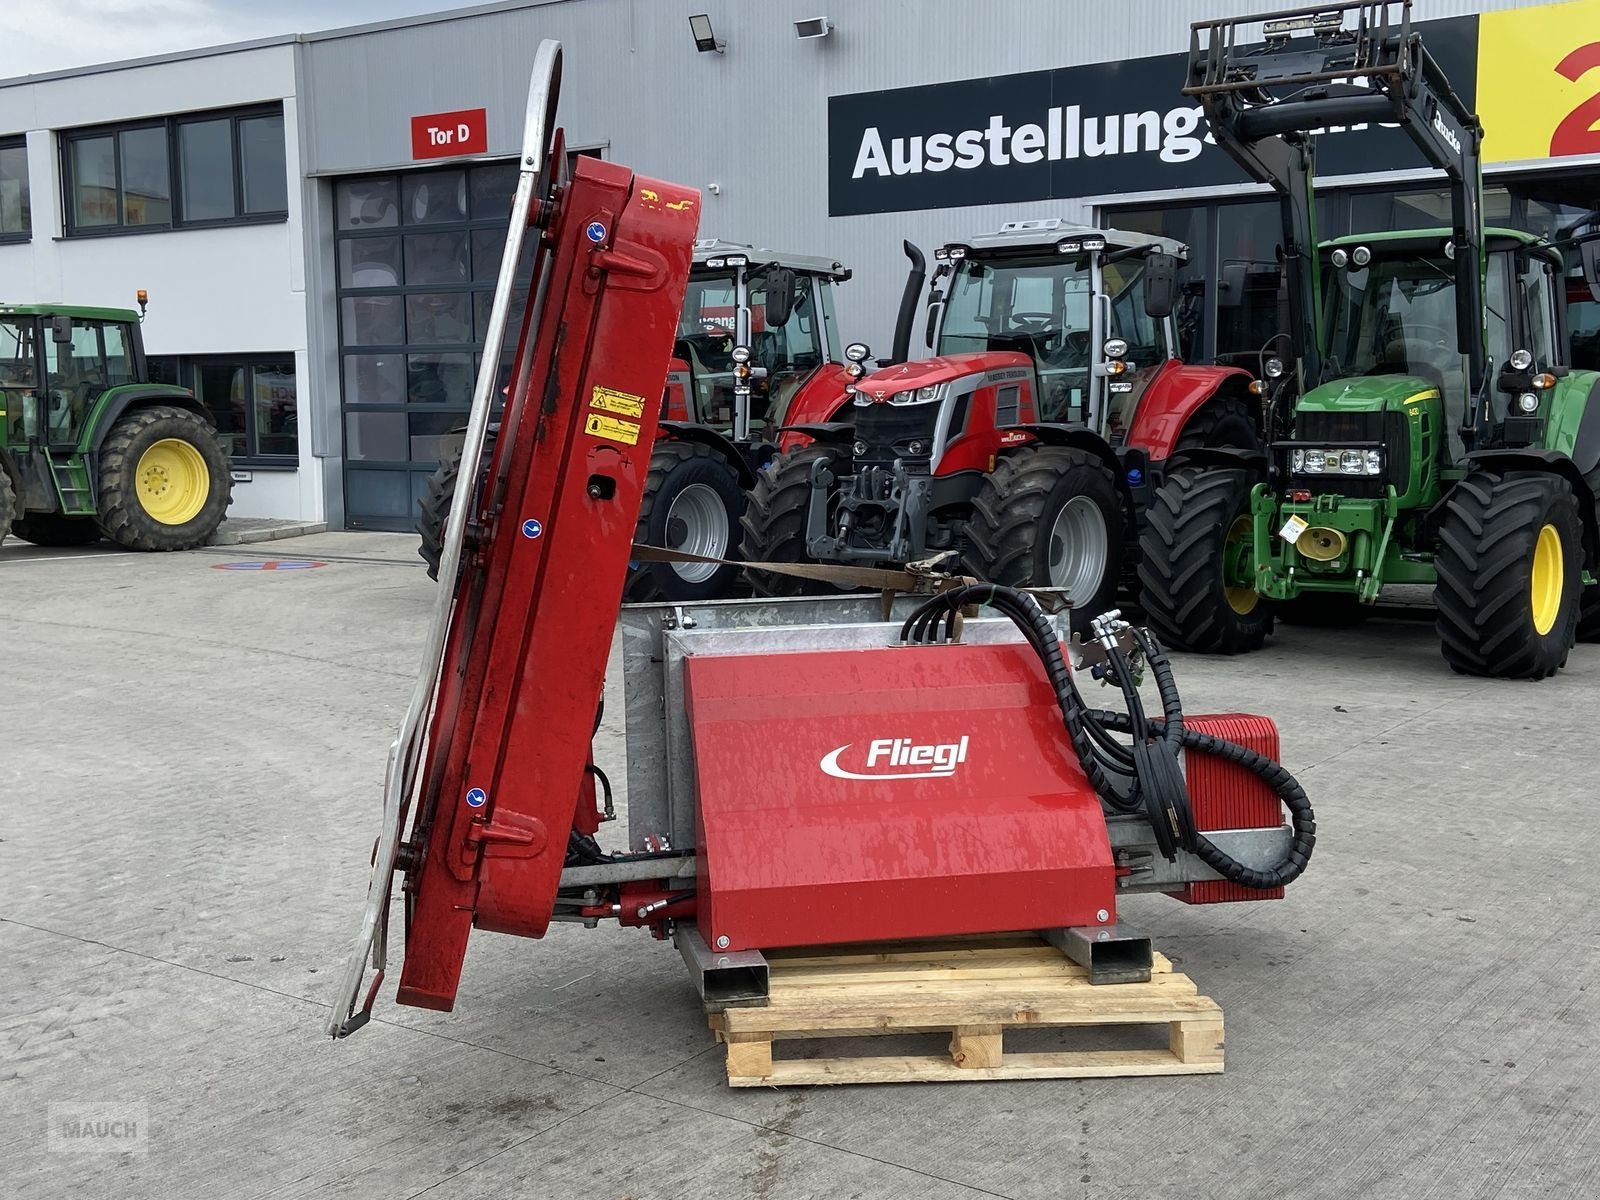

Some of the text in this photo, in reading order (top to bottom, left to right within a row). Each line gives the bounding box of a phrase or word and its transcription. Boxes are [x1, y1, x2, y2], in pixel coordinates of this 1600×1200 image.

[427, 124, 470, 146] Tor D
[866, 735, 969, 771] Fliegl
